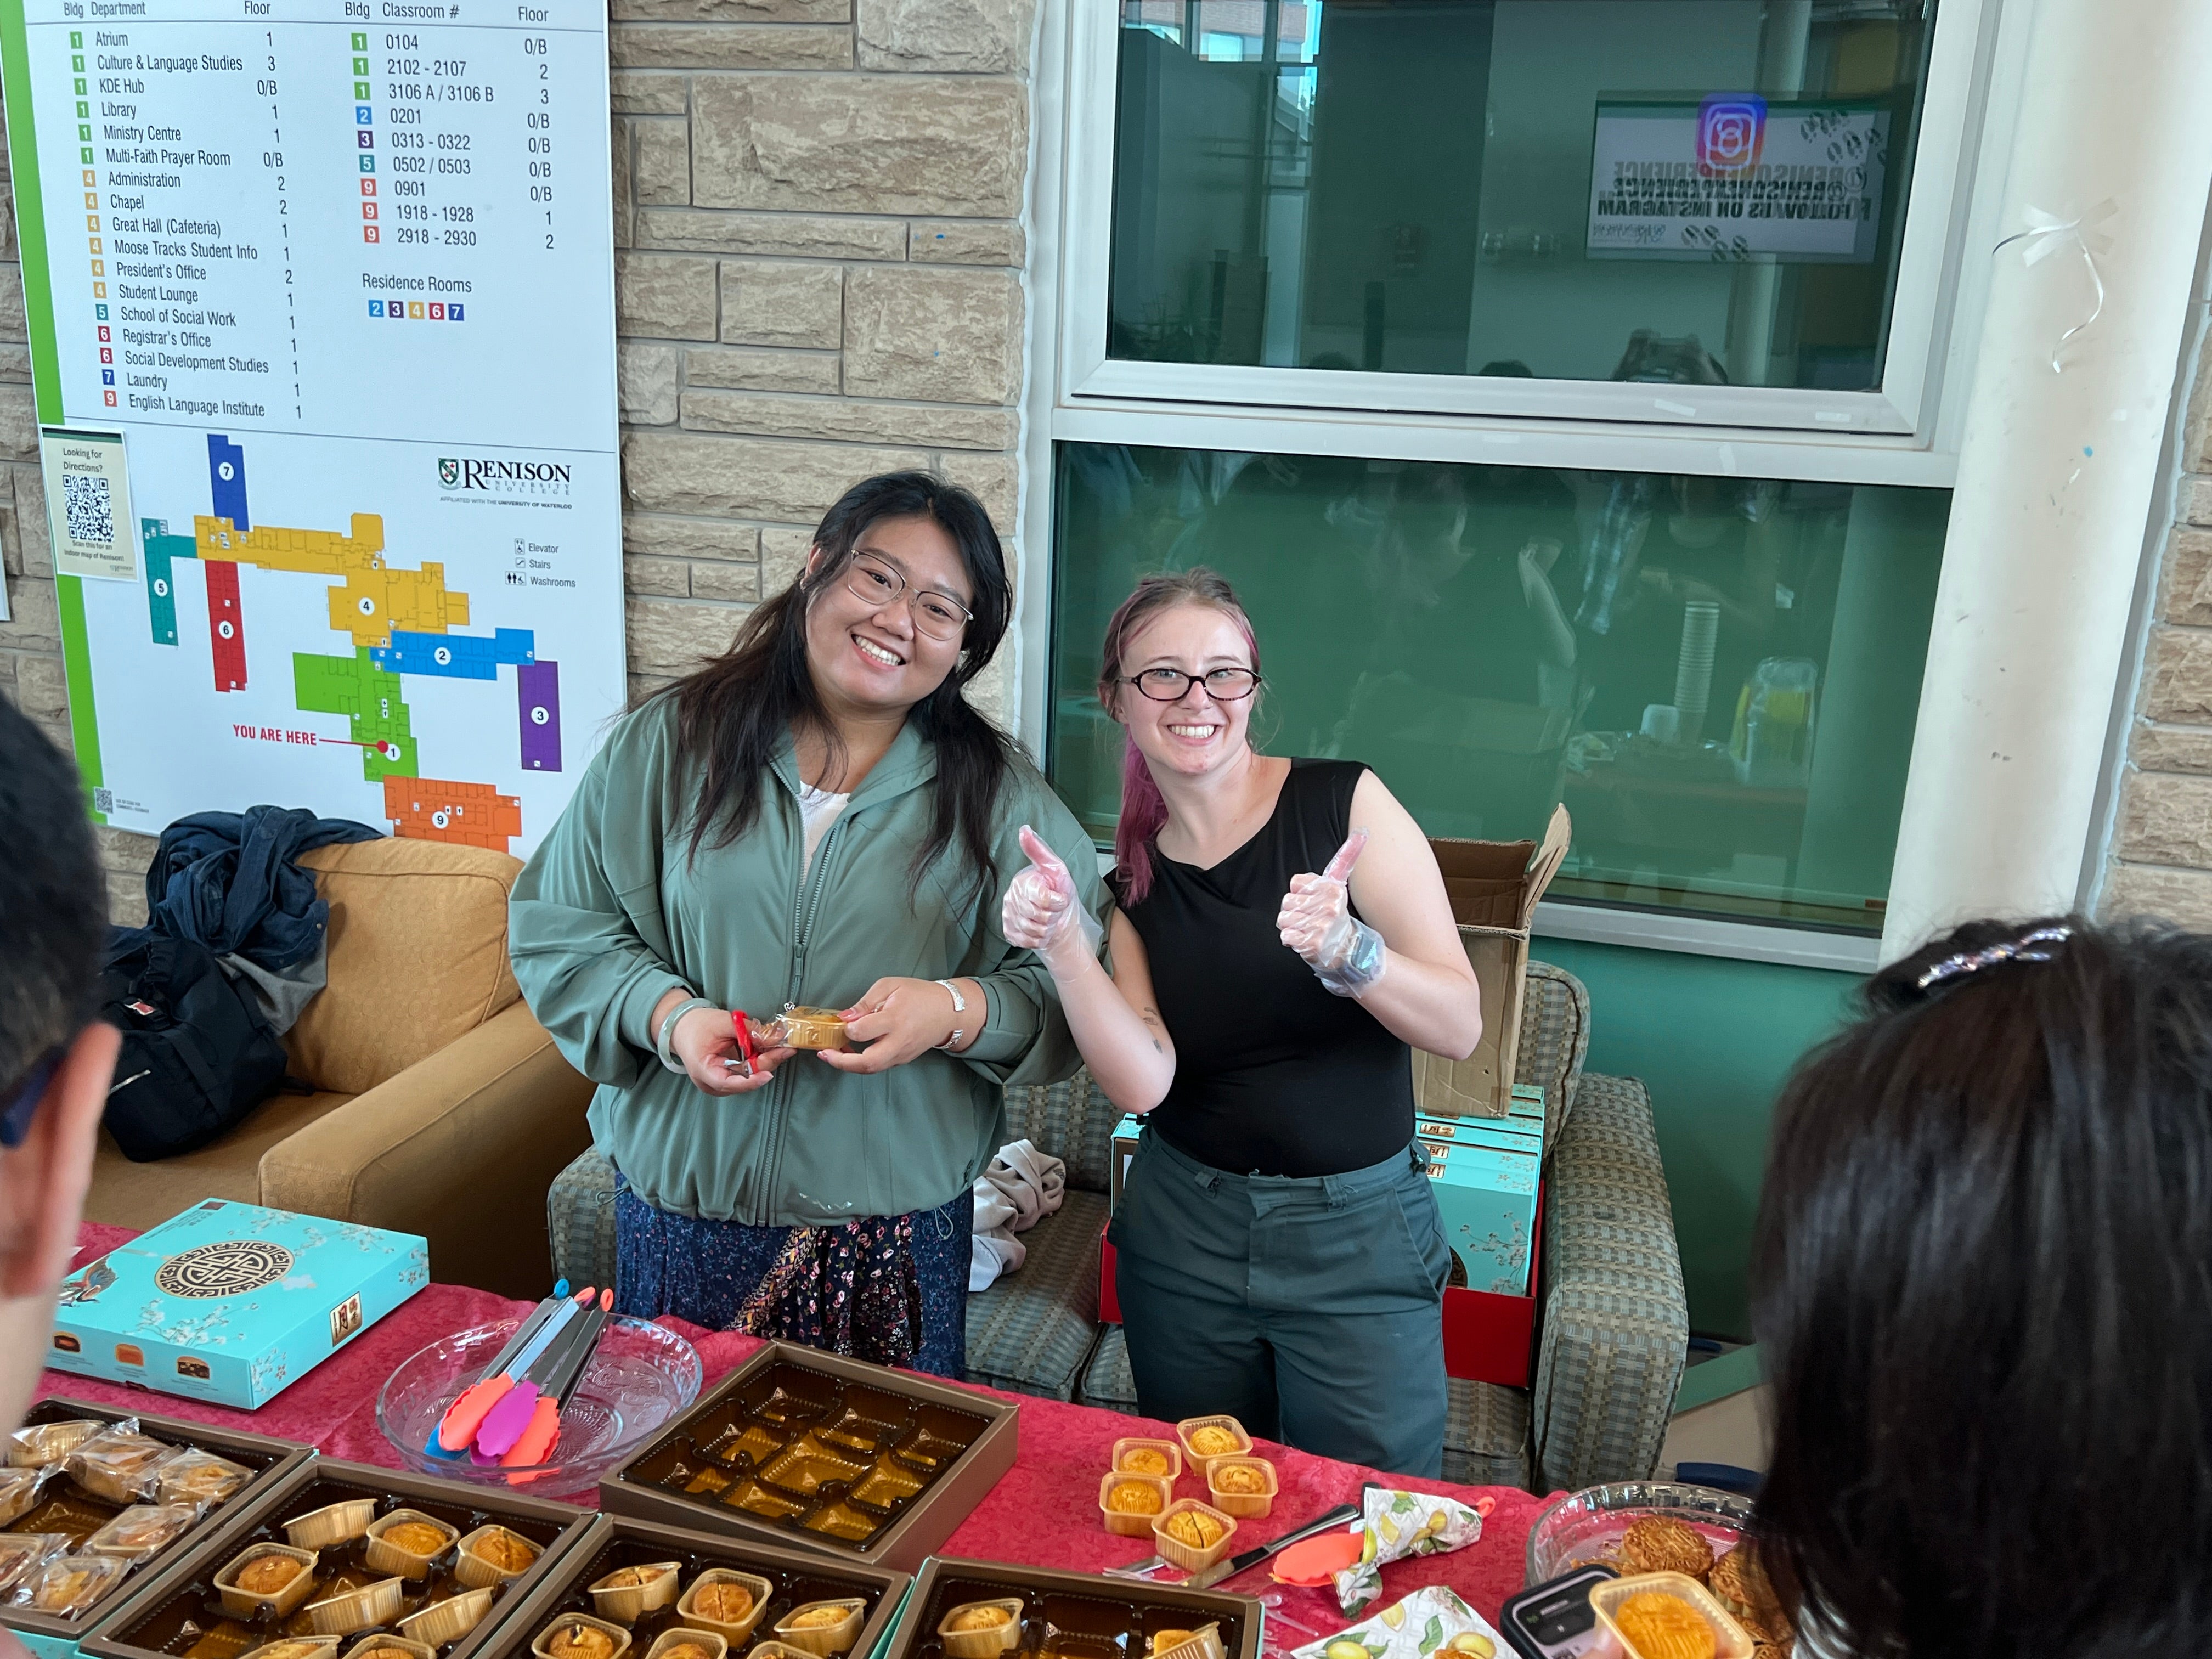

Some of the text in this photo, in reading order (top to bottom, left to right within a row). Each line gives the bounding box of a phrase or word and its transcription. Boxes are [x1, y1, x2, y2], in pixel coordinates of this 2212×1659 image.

[64, 1, 270, 19] Bldg Department Floor
[346, 2, 549, 21] Bldg Classroom Floor
[96, 31, 128, 46] Atrium
[267, 32, 272, 46] 1
[386, 34, 418, 50] 0104
[525, 38, 546, 55] 0/B
[98, 55, 132, 70] Culture
[147, 55, 198, 73] Language
[202, 55, 242, 70] Studies
[268, 56, 275, 71] 3
[388, 59, 420, 75] 2102
[434, 60, 466, 76] 2107
[540, 64, 548, 79] 2
[99, 78, 121, 93] KDE
[124, 78, 144, 93] Hub
[258, 80, 277, 97] 0/B
[390, 83, 421, 99] 3106
[426, 85, 435, 100] A
[448, 86, 481, 101] 3106
[486, 87, 493, 101] B
[541, 89, 549, 104] 3
[101, 102, 136, 120] Library
[272, 105, 277, 119] 1
[391, 108, 420, 123] 0201
[528, 113, 549, 129] 0/B
[104, 125, 144, 143] Ministry
[148, 126, 181, 140] Centre
[274, 129, 279, 143] 1
[392, 132, 424, 148] 0313
[438, 134, 470, 150] 0322
[529, 138, 550, 154] 0/B
[106, 148, 158, 163] Multi-Faith
[161, 149, 195, 167] Prayer
[198, 150, 230, 165] Room
[264, 152, 283, 168] 0/B
[393, 156, 425, 172] 0502
[438, 159, 470, 174] 0503
[529, 162, 551, 178] 0/B
[109, 171, 180, 187] Administration
[278, 176, 285, 190] 2
[395, 180, 425, 196] 0901
[531, 186, 552, 202] 0/B
[111, 194, 144, 212] Chapel
[280, 200, 287, 215] 2
[397, 205, 427, 220] 1918
[443, 207, 473, 222] 1928
[546, 211, 551, 225] 1
[113, 217, 139, 232] Great
[143, 218, 162, 233] Hall
[167, 219, 221, 239] (Cafeteria)
[283, 224, 287, 238] 1
[398, 228, 428, 244] 2918
[444, 230, 476, 246] 2930
[546, 234, 554, 249] 2
[115, 240, 148, 255] Moose
[152, 241, 186, 256] Tracks
[191, 242, 233, 258] Student
[237, 245, 257, 259] Info
[284, 247, 289, 261] 1
[117, 262, 172, 278] President's
[176, 264, 206, 280] Office
[286, 270, 292, 284] 2
[363, 273, 471, 292] Residence Rooms
[119, 284, 157, 300] Student
[160, 286, 198, 304] Lounge
[288, 293, 292, 306] 1
[121, 307, 155, 321] School
[159, 309, 168, 323] of
[173, 309, 204, 324] Social
[207, 312, 236, 326] Work
[290, 316, 294, 329] 1
[123, 329, 177, 346] Registrar's
[181, 332, 211, 347] Office
[291, 338, 296, 352] 1
[126, 351, 155, 365] Social
[159, 353, 226, 371] Development
[229, 357, 269, 373] Studies
[293, 361, 297, 374] 1
[127, 373, 167, 391] Laundry
[295, 383, 299, 397] 1
[129, 394, 165, 411] English
[168, 397, 218, 416] Language
[223, 400, 264, 416] Institute
[296, 405, 301, 419] 1
[63, 448, 102, 460] Looking for
[64, 461, 103, 473] Directions?
[224, 466, 229, 476] 7
[461, 459, 571, 489] RENISON
[486, 480, 570, 489] UNIVERSITY
[495, 486, 569, 495] COLLEGE
[529, 543, 558, 553] Elevator
[529, 559, 551, 569] Stairs
[159, 583, 164, 592] 5
[531, 577, 575, 587] Washrooms
[363, 601, 369, 610] 4
[223, 625, 229, 635] 6
[439, 651, 445, 660] 2
[538, 711, 544, 720] 3
[233, 725, 316, 745] YOU ARE HERE
[391, 748, 395, 757] 1
[437, 816, 443, 825] 9
